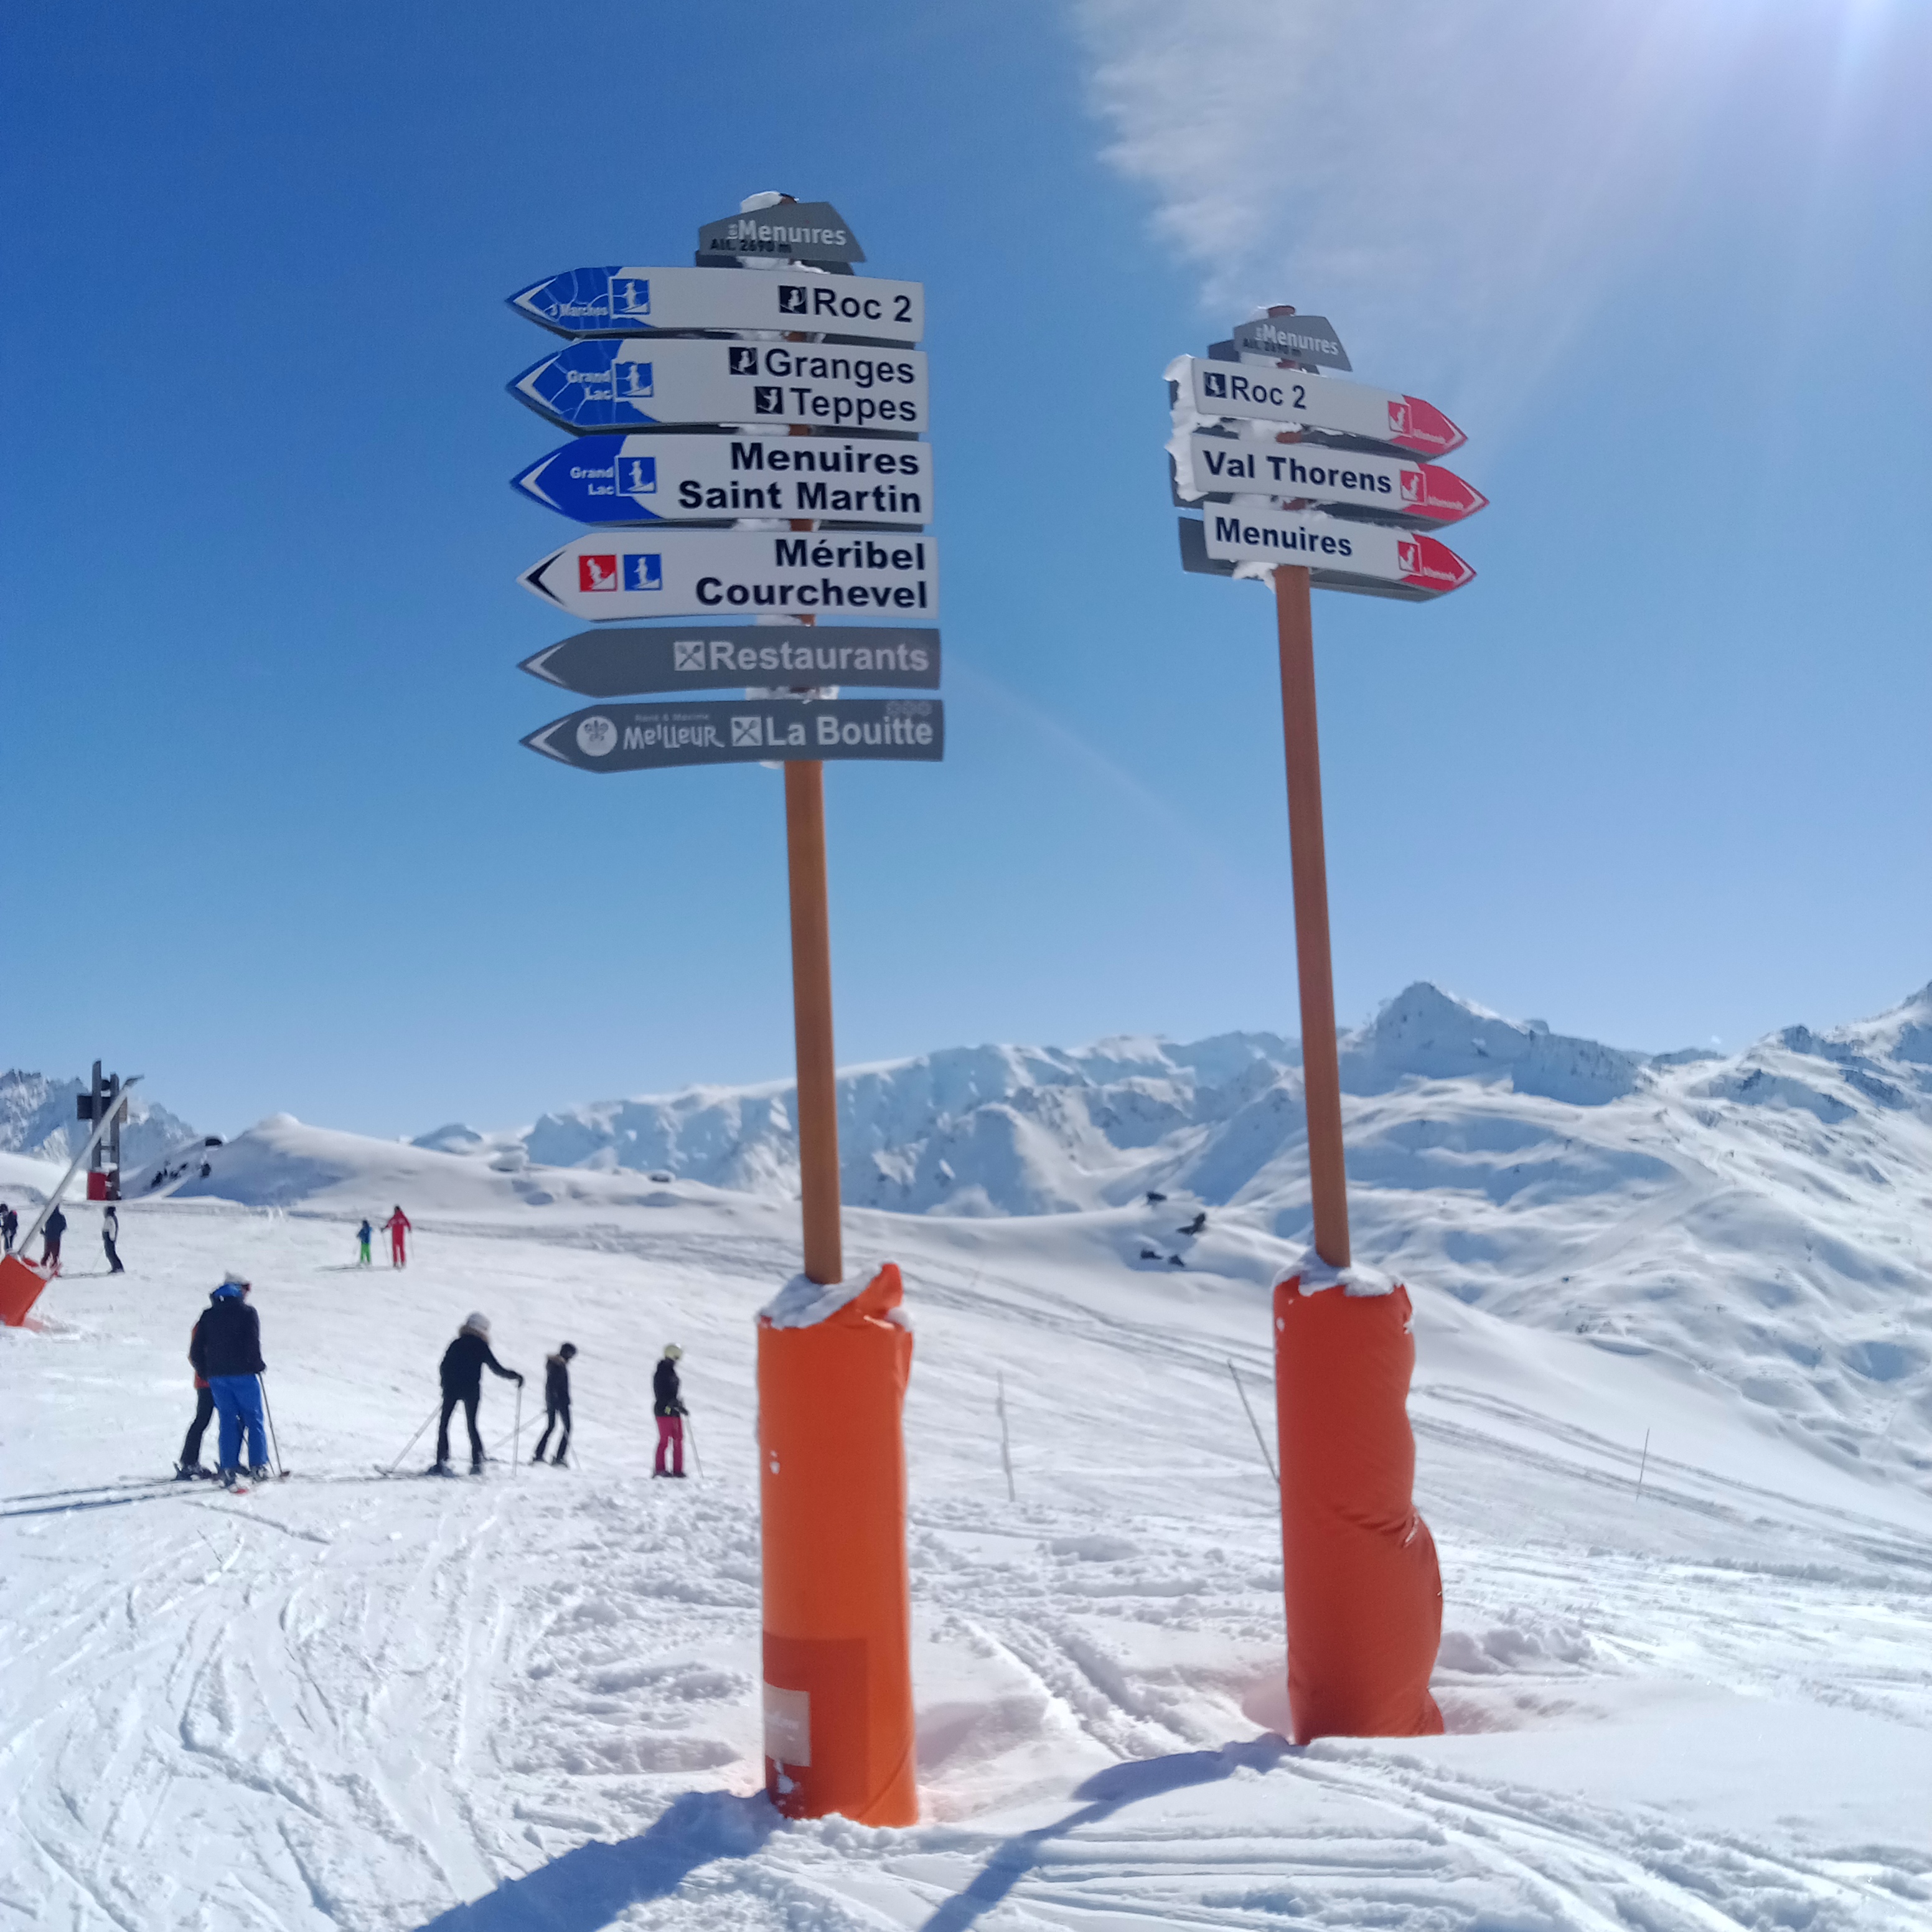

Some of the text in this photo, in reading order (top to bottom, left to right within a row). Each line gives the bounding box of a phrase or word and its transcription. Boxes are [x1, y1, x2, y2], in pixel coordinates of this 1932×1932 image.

[738, 219, 847, 246] Menuires
[813, 287, 912, 322] Roc 2
[1263, 323, 1339, 356] Menuires
[566, 370, 612, 383] Grand
[764, 349, 915, 387] Granges
[584, 386, 613, 400] Lac
[789, 386, 917, 424] Teppes
[1230, 375, 1306, 410] Roc 2
[570, 466, 614, 479] Grand
[731, 441, 919, 474] Menuires
[1202, 450, 1392, 494] Val Thorens
[588, 483, 614, 495] Lac
[678, 480, 921, 513] Saint Martin
[1216, 517, 1352, 558] Menuires
[776, 539, 926, 570] Méribel
[695, 576, 928, 609] Courchevel
[710, 642, 929, 671] Restaurants
[766, 716, 933, 746] La Bouitte
